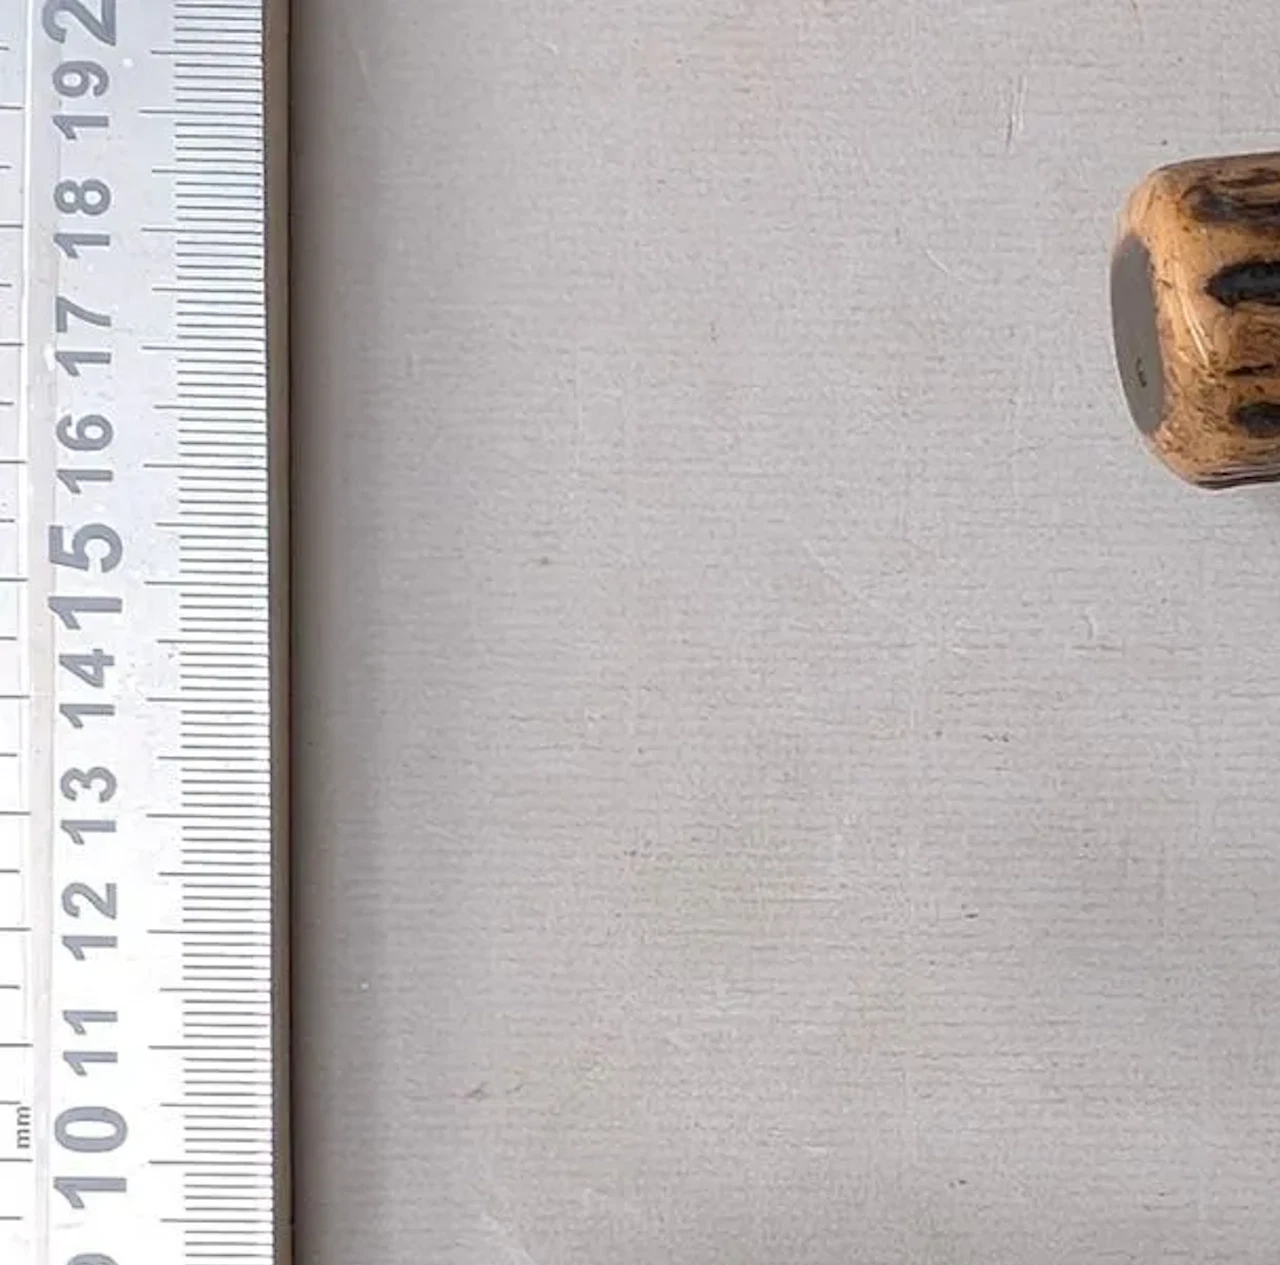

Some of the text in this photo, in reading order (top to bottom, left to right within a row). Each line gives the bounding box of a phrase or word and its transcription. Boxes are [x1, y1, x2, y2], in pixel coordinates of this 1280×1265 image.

[52, 61, 110, 140] 19
[53, 180, 111, 259] 18
[54, 296, 112, 377] 17
[56, 415, 114, 494] 16
[48, 524, 124, 630] 15
[59, 649, 117, 729] 14
[60, 767, 118, 845] 13
[61, 882, 119, 961] 12
[62, 1010, 119, 1076] 11
[17, 1106, 32, 1150] mm
[53, 1106, 129, 1209] 10
